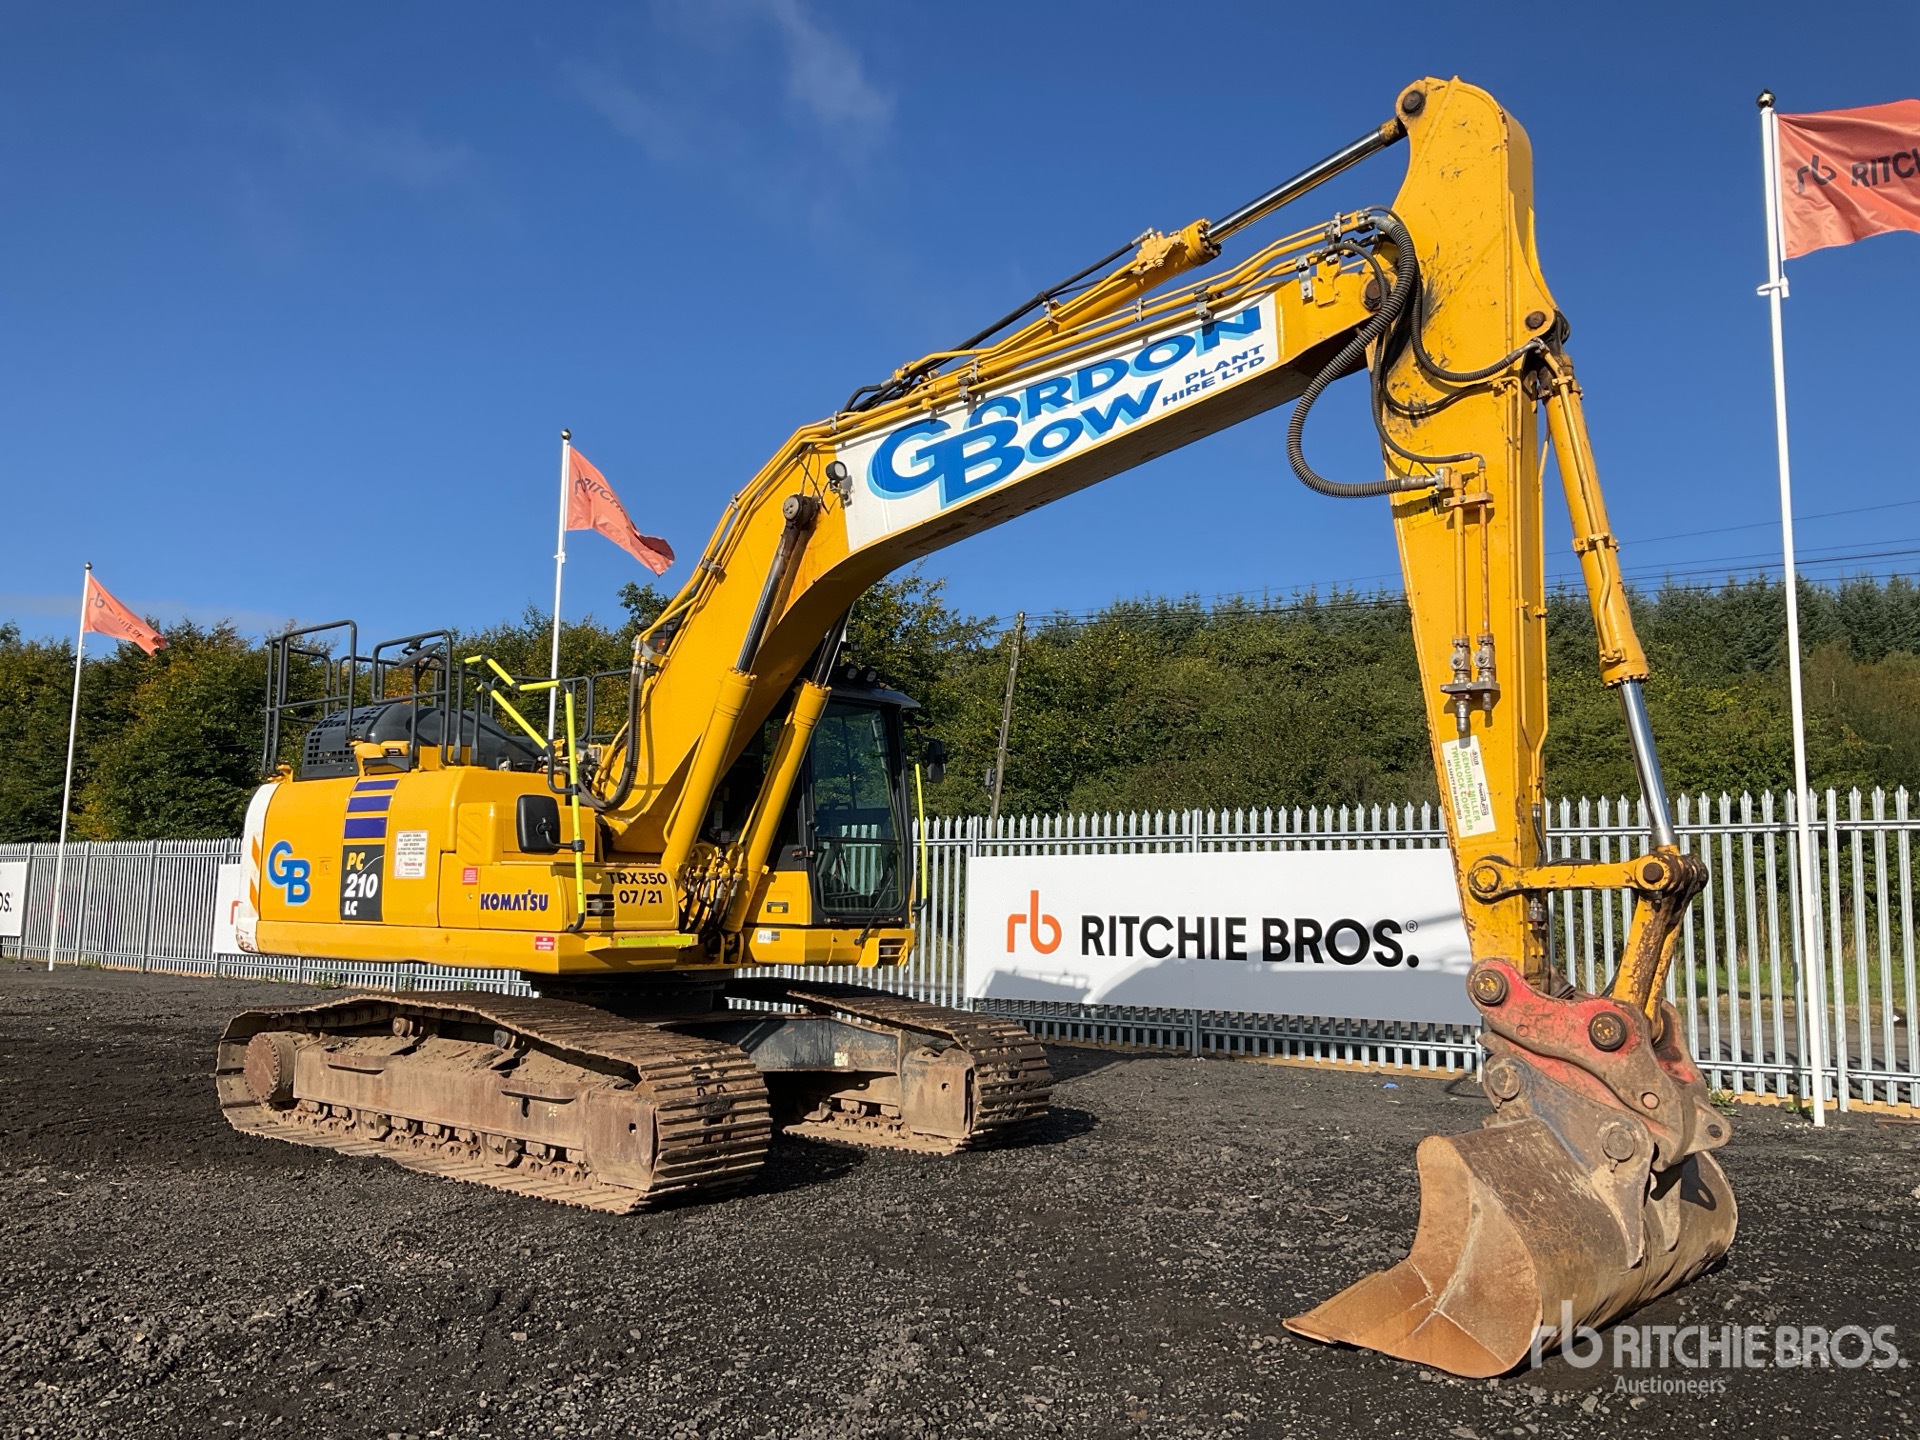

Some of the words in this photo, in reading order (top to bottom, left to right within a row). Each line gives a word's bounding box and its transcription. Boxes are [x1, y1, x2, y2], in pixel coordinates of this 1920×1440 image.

[1797, 154, 1837, 194] rb
[1162, 376, 1216, 407] HIRE
[1220, 355, 1267, 381] LTD
[1184, 344, 1265, 385] PLANT
[866, 306, 1263, 501] GORDON
[1451, 745, 1465, 790] TWINLOCK
[1461, 750, 1475, 787] GENUINE
[1469, 787, 1481, 822] MILLER
[346, 851, 366, 871] PC
[605, 872, 668, 885] TRX350
[344, 873, 379, 899] 210
[480, 889, 549, 912] KOMATSU
[619, 889, 663, 906] 07/21
[344, 901, 358, 916] LC
[1006, 889, 1062, 955] rb
[1081, 914, 1248, 961] RITCHIE
